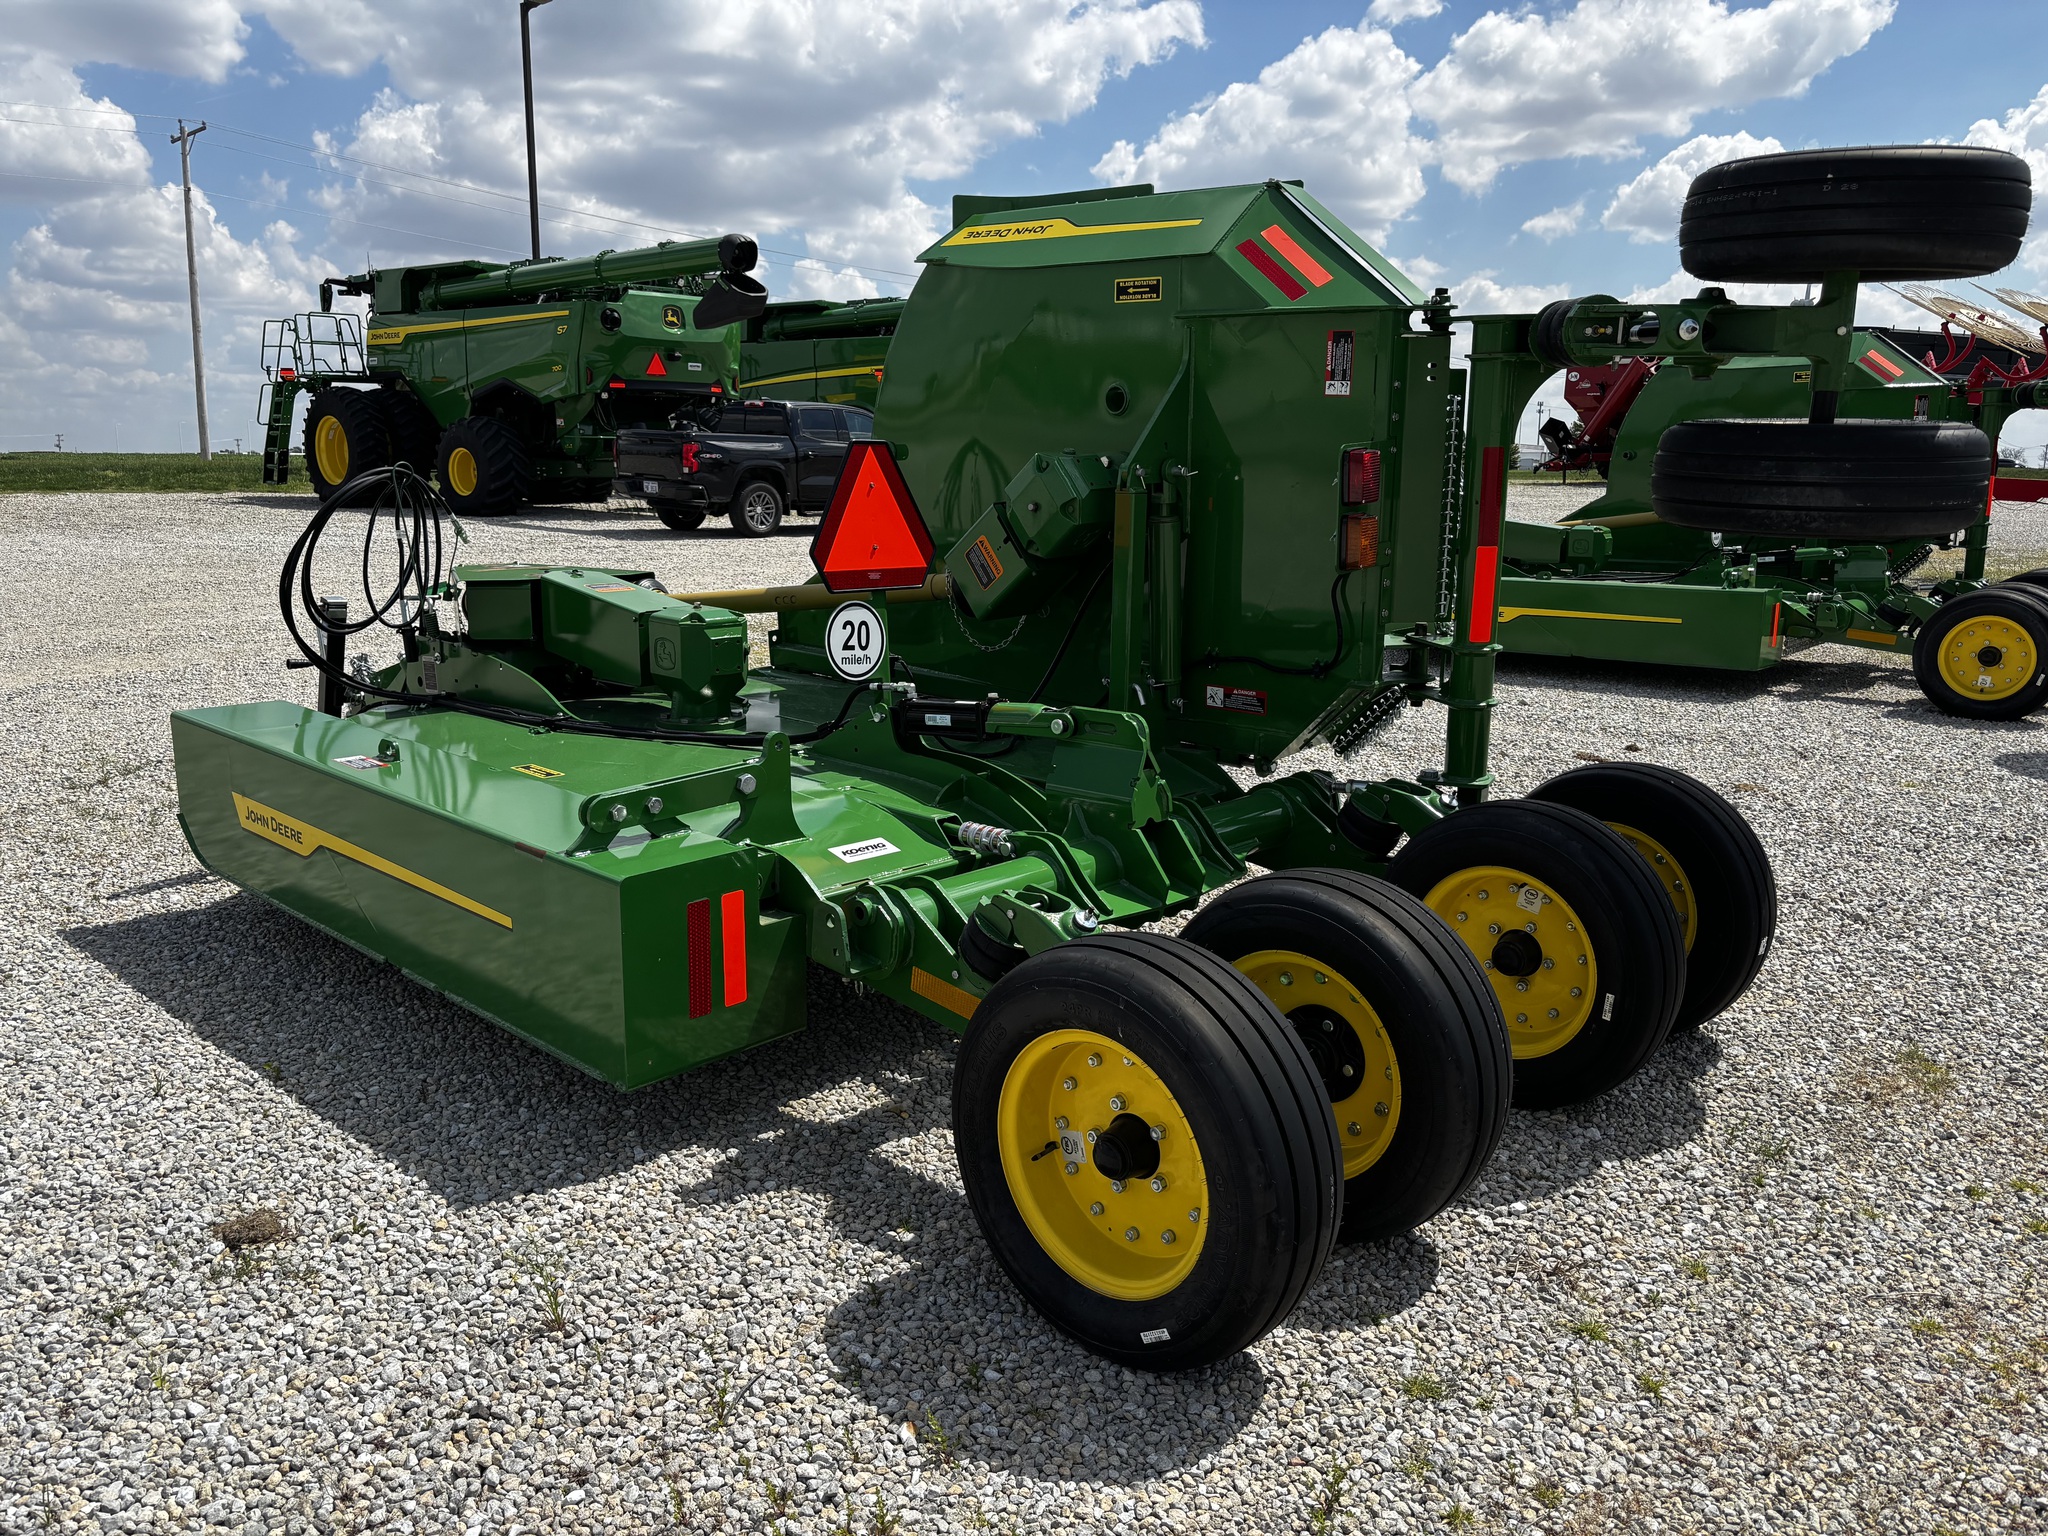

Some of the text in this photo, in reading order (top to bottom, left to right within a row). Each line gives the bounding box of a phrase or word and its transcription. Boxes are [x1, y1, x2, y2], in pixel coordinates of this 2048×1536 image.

[963, 225, 1053, 239] JOHN DEERE
[383, 331, 401, 339] DEERE
[556, 325, 568, 335] S7
[551, 364, 562, 372] 700
[984, 545, 1001, 575] WARNING
[841, 620, 870, 651] 20
[841, 654, 871, 665] mile/h
[245, 806, 303, 845] JOHN DEERE
